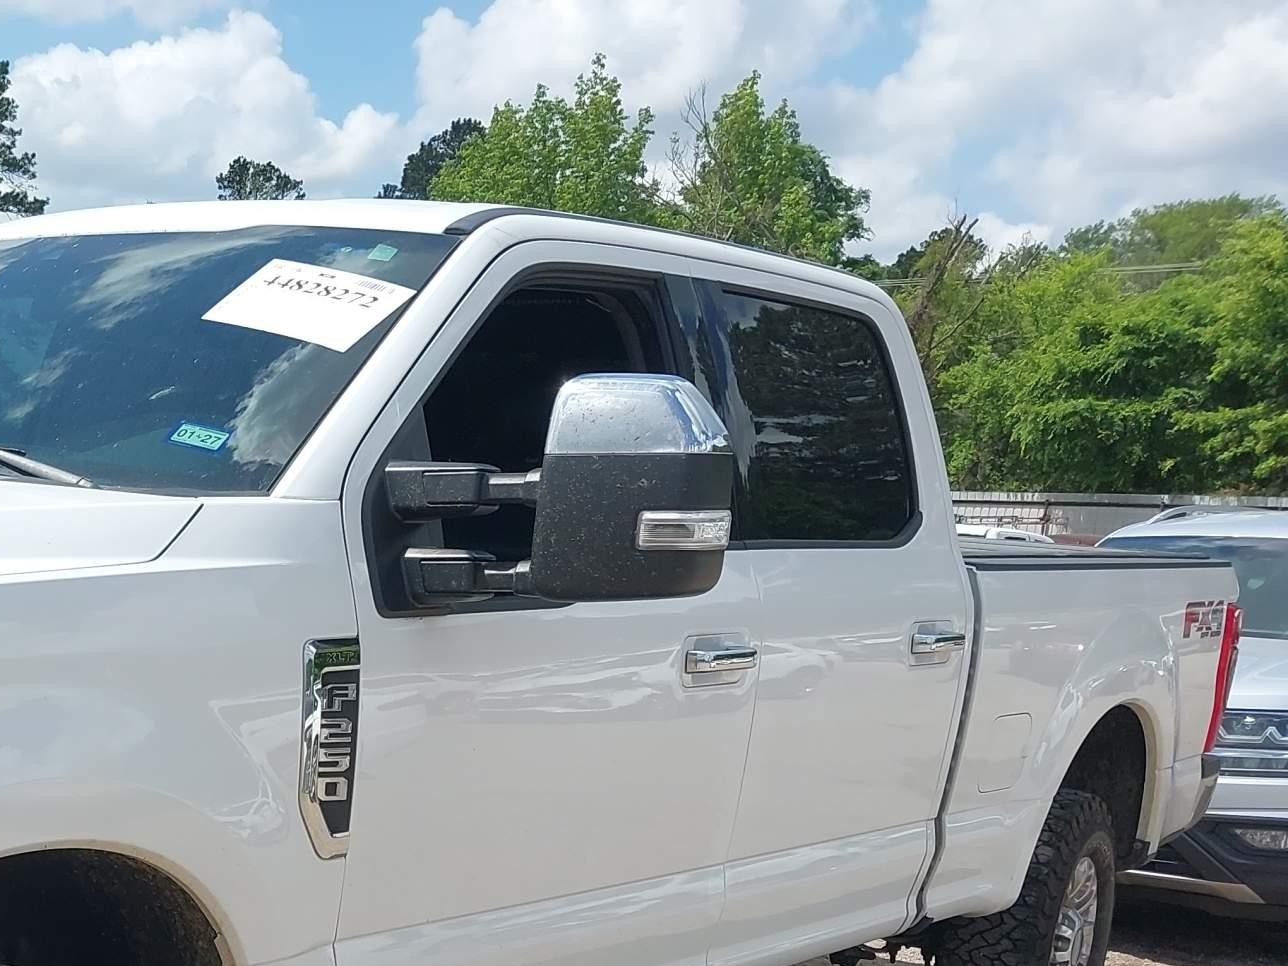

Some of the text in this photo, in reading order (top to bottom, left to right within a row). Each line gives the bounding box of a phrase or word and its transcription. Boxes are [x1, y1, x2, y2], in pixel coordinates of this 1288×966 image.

[263, 275, 379, 309] 44828272
[1182, 600, 1225, 639] FX4
[327, 651, 355, 664] XLT
